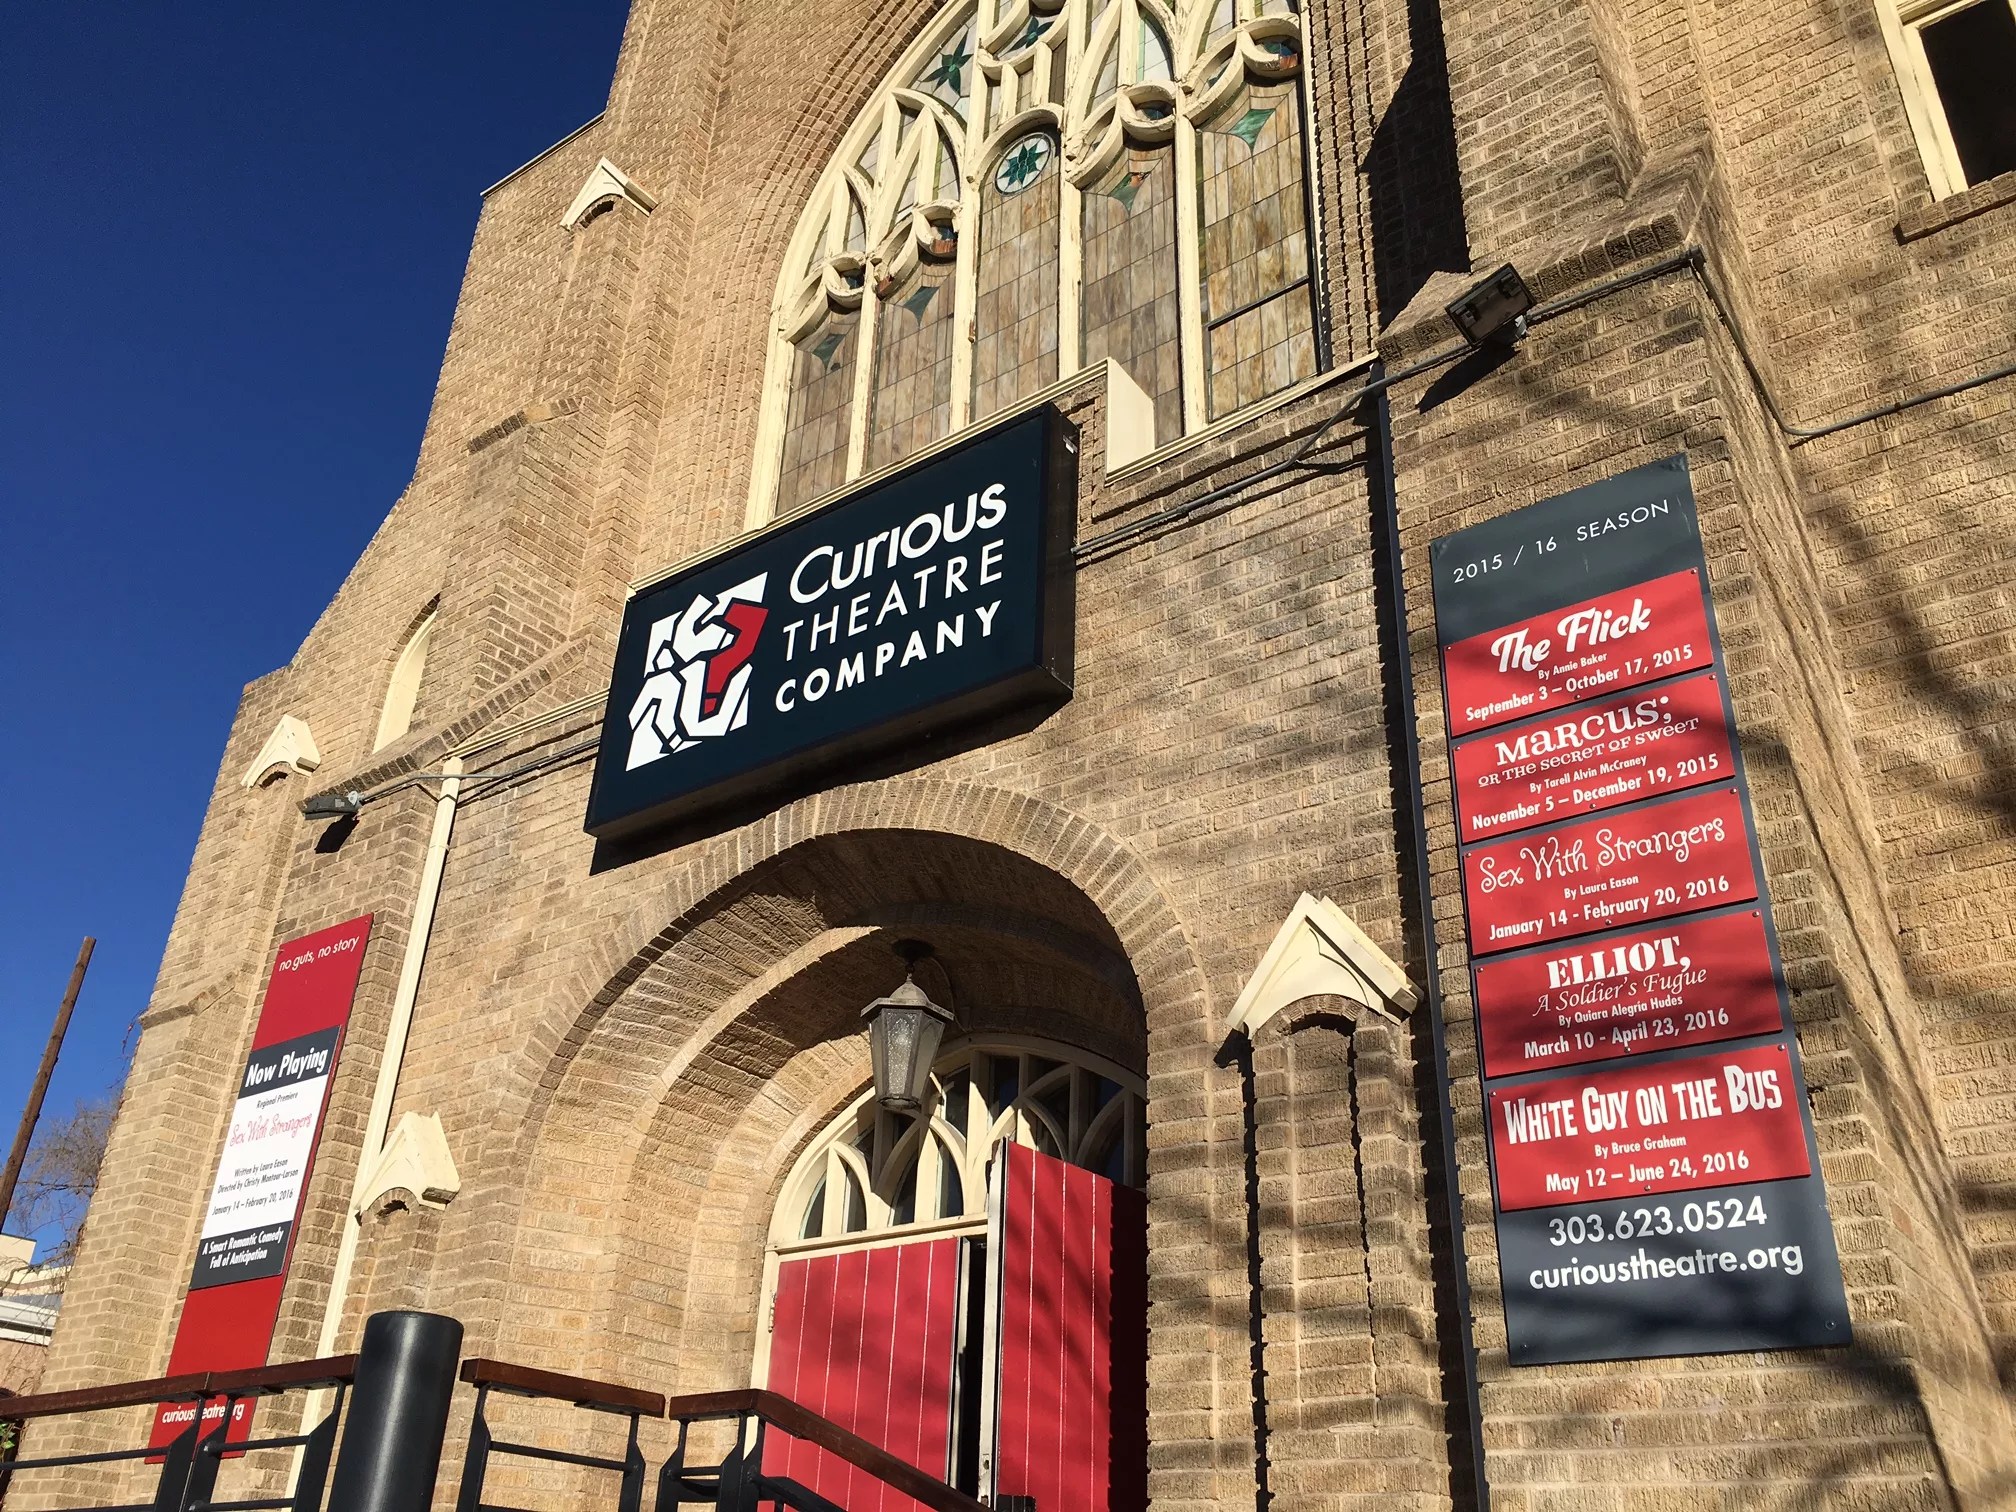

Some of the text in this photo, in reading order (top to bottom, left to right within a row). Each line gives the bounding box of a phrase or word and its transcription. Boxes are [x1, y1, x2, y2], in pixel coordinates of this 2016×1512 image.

[1453, 499, 1669, 584] 2015 / 16 SEASON
[783, 539, 1004, 661] THEATRE
[775, 600, 1002, 712] COMPANY
[1491, 598, 1651, 672] The Flick
[1465, 690, 1534, 721] September
[1539, 686, 1548, 700] 3
[1566, 667, 1619, 693] October
[1625, 658, 1648, 676] 17,
[1653, 644, 1693, 668] 2015
[1538, 652, 1608, 680] By Annie Baker
[1472, 805, 1540, 830] November
[1545, 796, 1554, 812] 5
[1573, 776, 1641, 805] December
[1648, 767, 1672, 785] 19,
[1677, 753, 1719, 778] 2015
[1529, 755, 1647, 794] By Tarell Alvin McCraney
[1479, 817, 1726, 894] Sex With Strangers
[1489, 917, 1544, 940] January
[1549, 909, 1568, 927] 14
[1584, 895, 1649, 921] February
[1654, 886, 1681, 906] 20,
[1686, 875, 1729, 899] 2016
[1564, 875, 1639, 900] By Laura Eason
[279, 936, 359, 971] no guts, no story
[1546, 936, 1691, 989] ELLIOT,
[1532, 969, 1707, 1017] A Soldier's Fugue
[1558, 1014, 1572, 1028] By
[1575, 1008, 1608, 1024] Quiara
[1650, 995, 1683, 1009] Hudes
[1524, 1035, 1570, 1059] March
[1575, 1031, 1594, 1050] 10
[1612, 1024, 1648, 1051] April
[1653, 1017, 1680, 1037] 23,
[1684, 1007, 1729, 1031] 2016
[245, 1047, 328, 1087] Now Playing
[257, 1092, 298, 1109] Regional Premiere
[1635, 1085, 1669, 1127] ON
[1671, 1077, 1723, 1121] THE
[230, 1113, 312, 1147] Sex With Strangers
[1594, 1135, 1687, 1159] By Bruce Graham
[218, 1182, 239, 1194] Directed
[237, 1182, 243, 1191] by
[244, 1177, 260, 1187] Christy
[234, 1159, 288, 1178] Written by Laura Eason
[1546, 1174, 1580, 1195] May
[1586, 1167, 1607, 1187] 12
[1628, 1164, 1664, 1183] June
[1669, 1158, 1698, 1179] 24,
[1702, 1150, 1749, 1173] 2016
[212, 1204, 232, 1215] January
[233, 1201, 240, 1210] 14
[245, 1196, 267, 1209] February
[269, 1192, 277, 1203] 20,
[278, 1188, 294, 1201] 2016
[1549, 1195, 1768, 1247] 303.623.0524
[202, 1227, 284, 1255] A Smart Romantic Comedy
[210, 1247, 268, 1269] Full of Anticipation
[1529, 1245, 1804, 1290] curioustheatre.org
